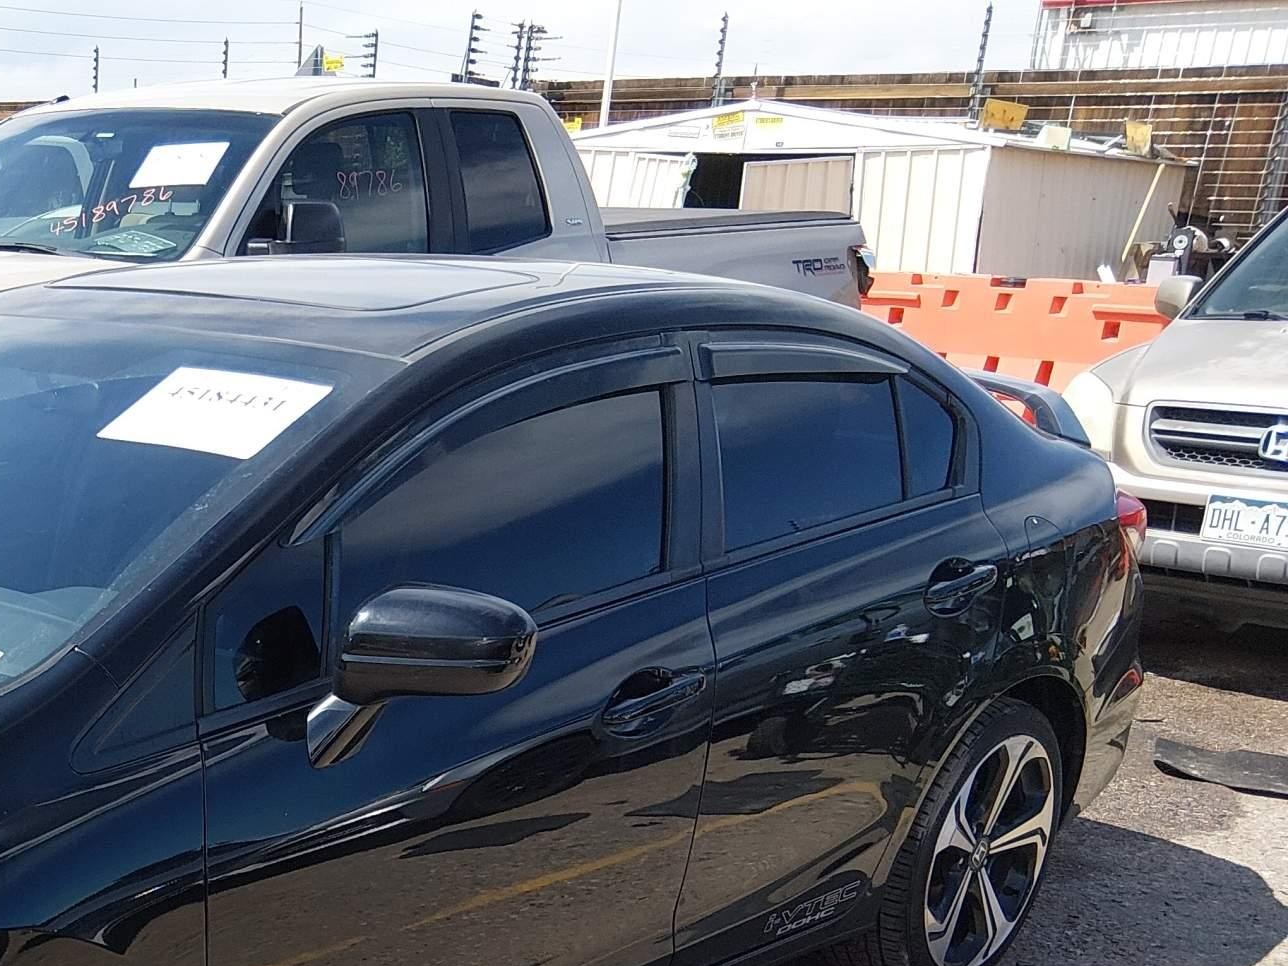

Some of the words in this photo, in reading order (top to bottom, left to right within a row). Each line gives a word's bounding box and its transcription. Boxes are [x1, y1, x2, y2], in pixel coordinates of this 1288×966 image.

[337, 169, 402, 200] 89786
[50, 186, 172, 236] 45189786
[792, 258, 822, 277] TRD
[1209, 508, 1244, 532] DHL
[1226, 532, 1275, 544] COLORADO
[776, 906, 836, 935] DOHC
